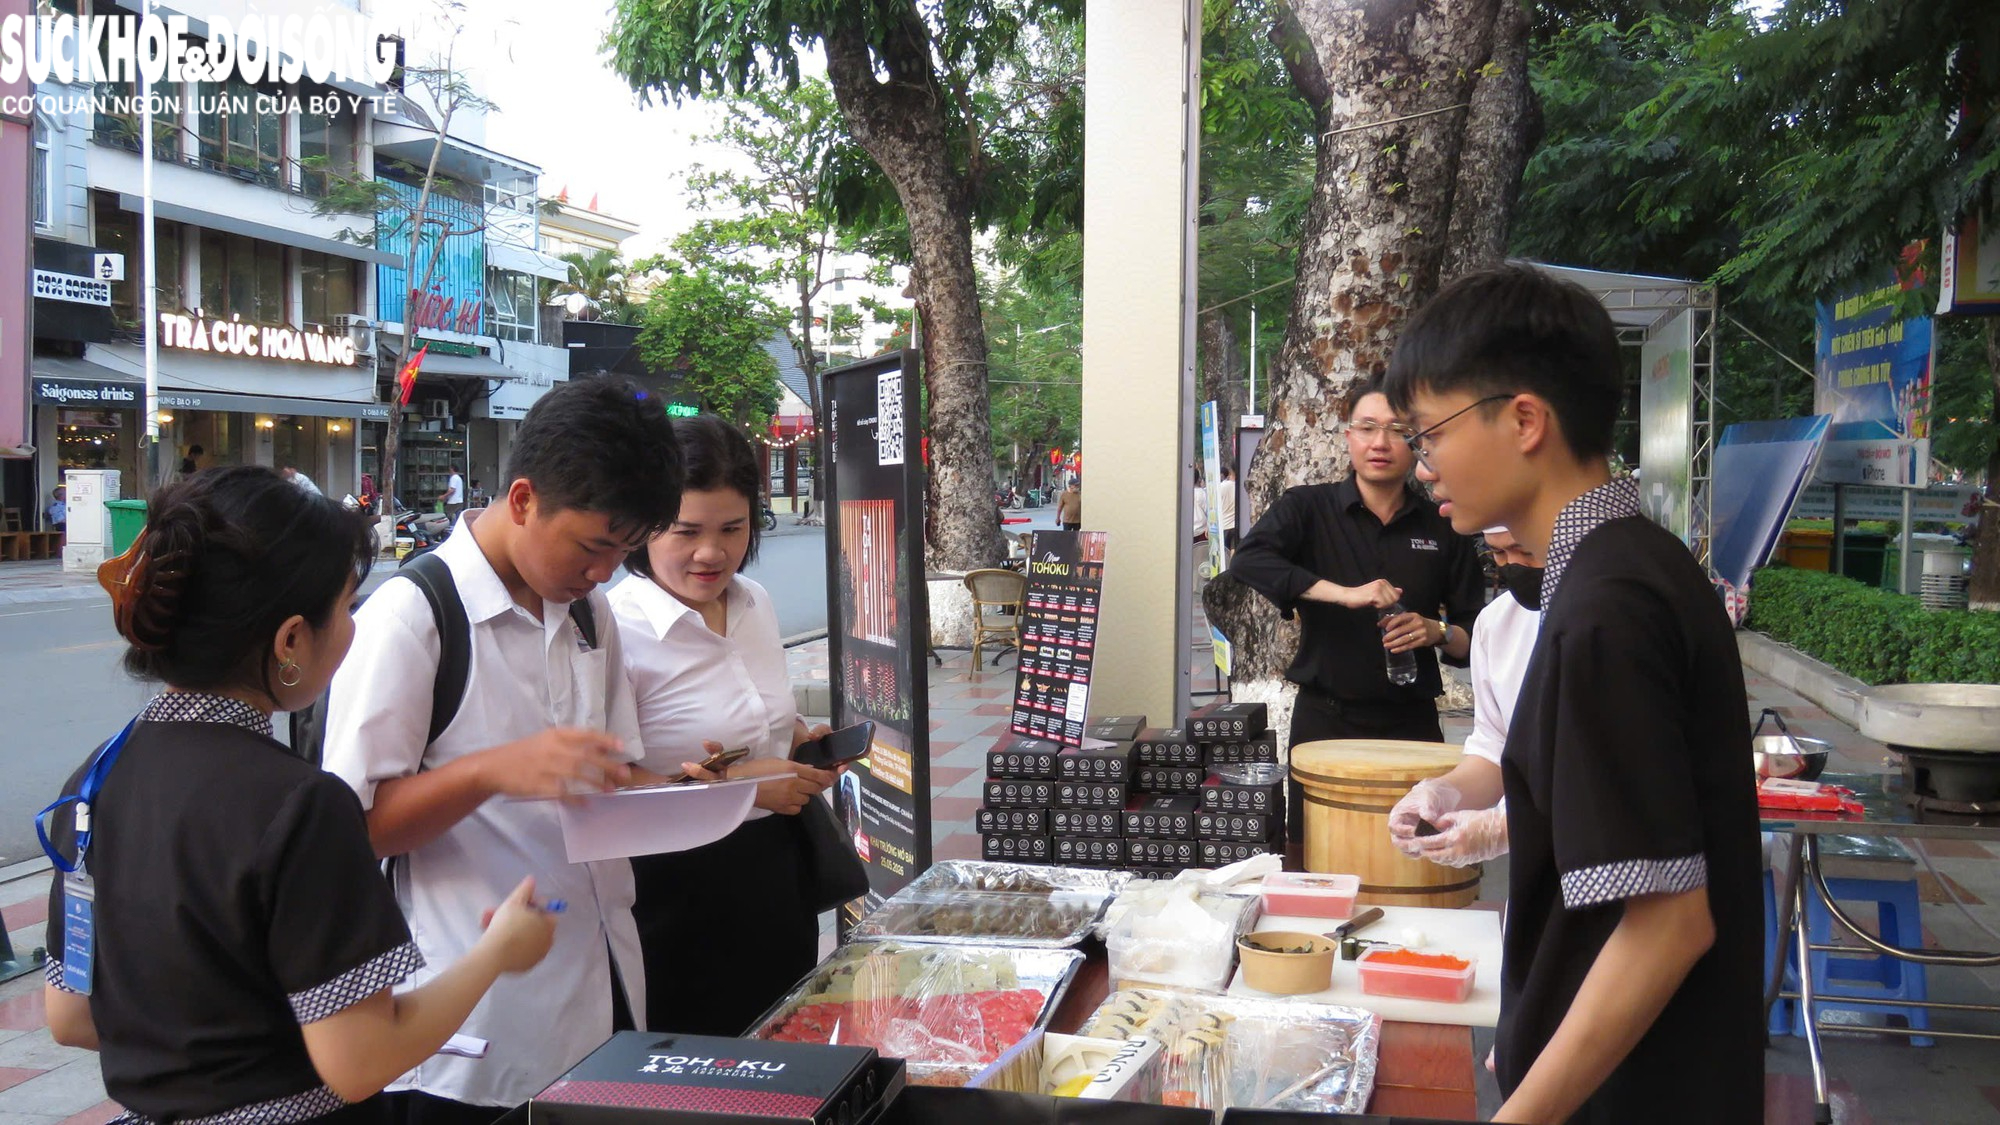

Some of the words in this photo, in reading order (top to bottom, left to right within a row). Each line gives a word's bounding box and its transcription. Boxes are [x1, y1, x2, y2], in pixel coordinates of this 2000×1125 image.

[65, 278, 108, 302] COFFEE
[160, 308, 210, 351] TRÀ
[211, 313, 259, 356] CÚC
[262, 326, 306, 361] HOA
[305, 325, 355, 366] VÀNG
[41, 383, 99, 402] Saigonese
[101, 386, 135, 401] drinks
[1032, 562, 1069, 576] TOHOKU
[648, 1055, 787, 1072] TOHOKU
[1093, 1039, 1148, 1084] RINGO
